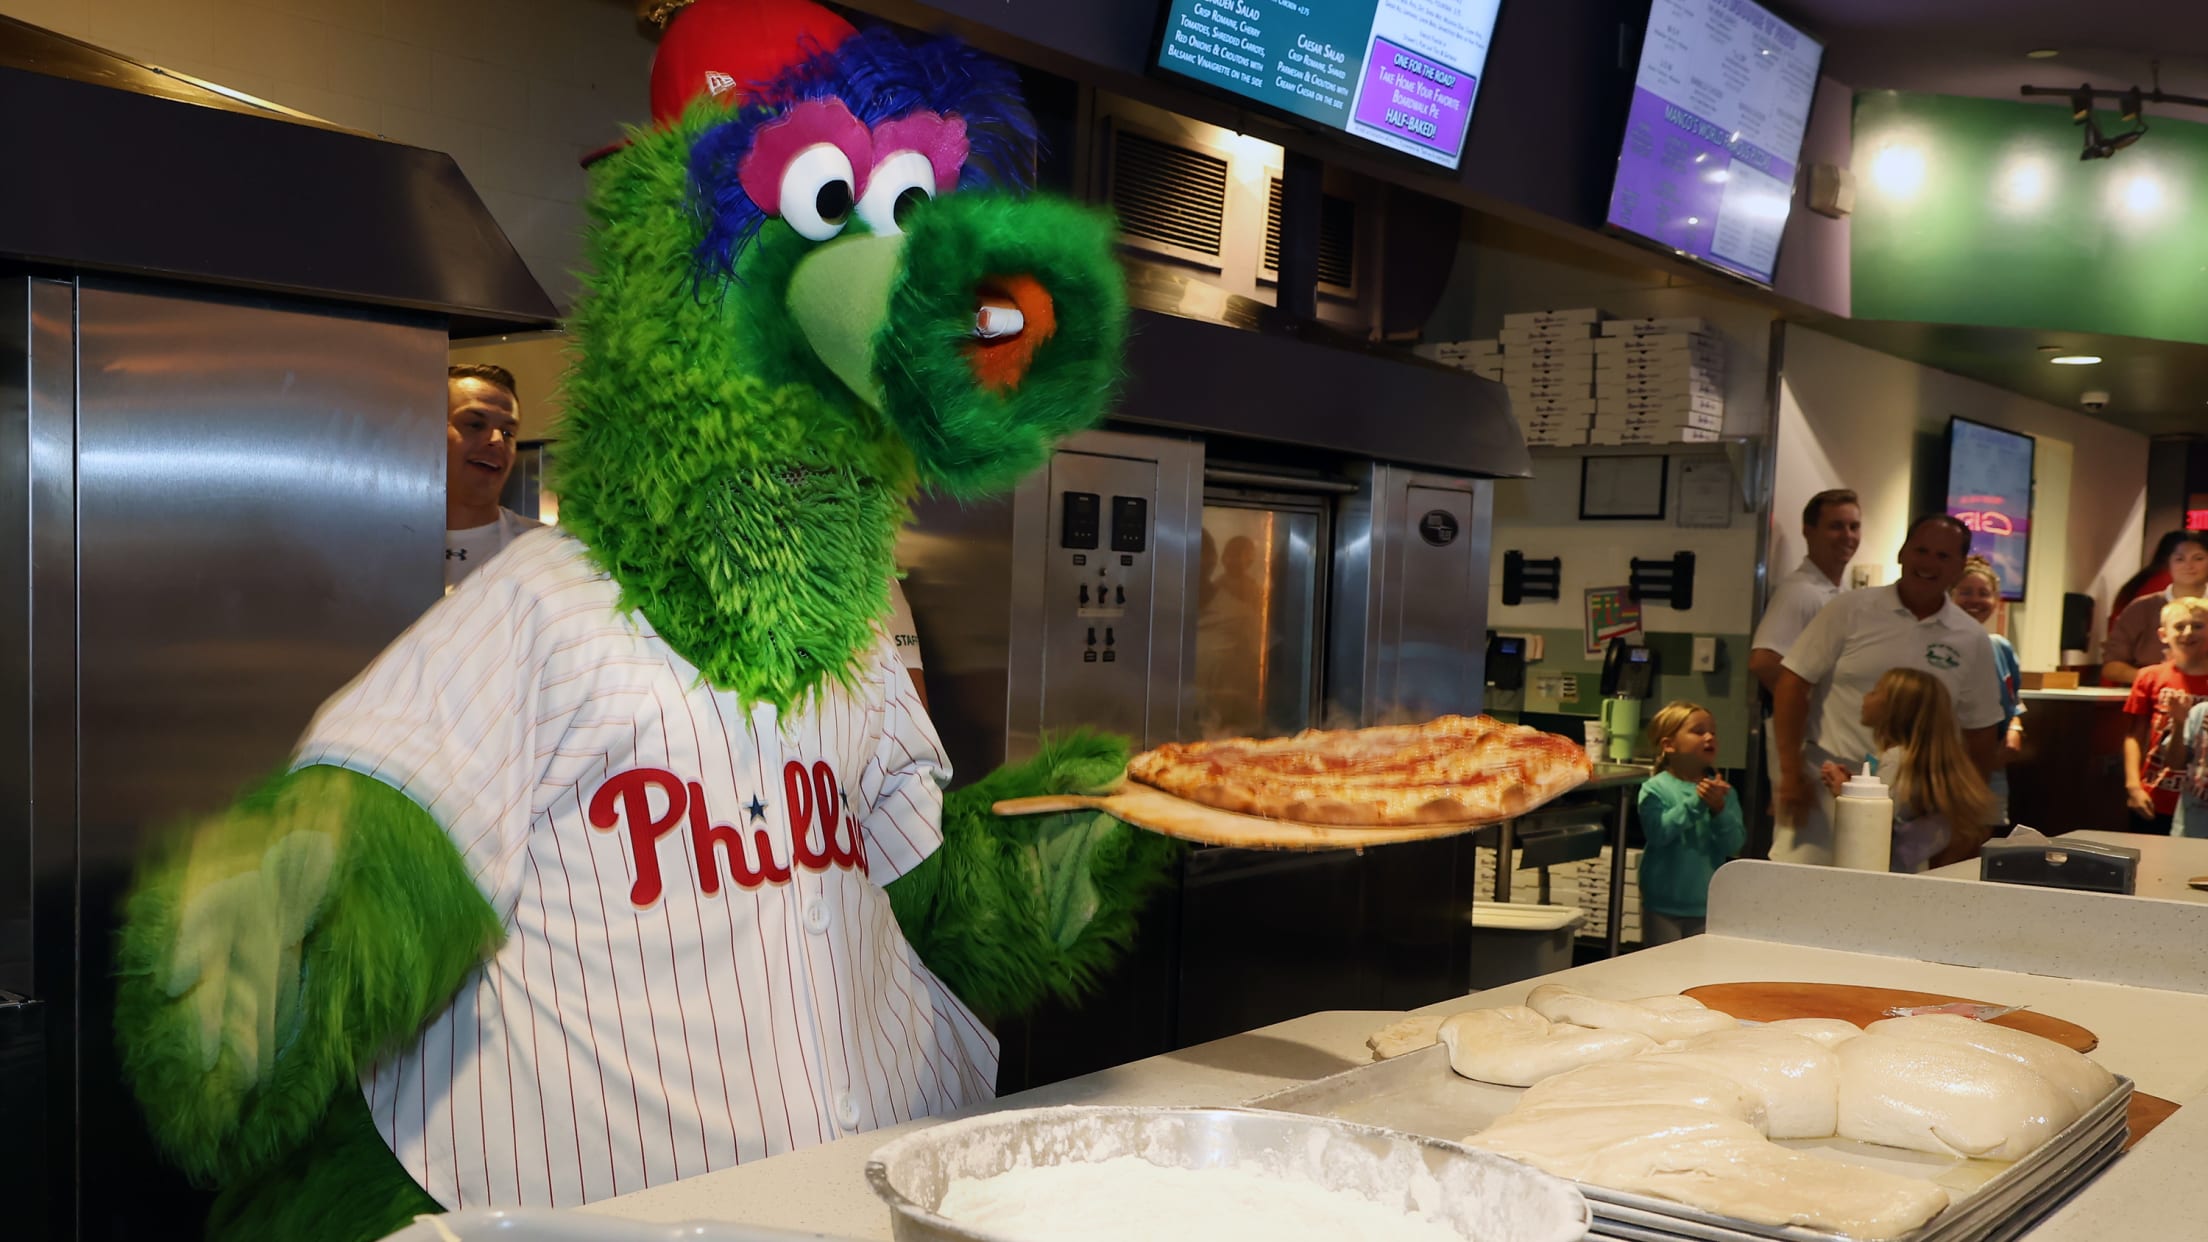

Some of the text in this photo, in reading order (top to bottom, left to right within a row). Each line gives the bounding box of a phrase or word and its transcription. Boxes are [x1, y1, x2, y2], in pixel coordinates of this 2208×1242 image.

[1194, 3, 1211, 18] CRISP
[1240, 21, 1261, 38] CHERRY
[1236, 0, 1260, 20] SALAD
[1175, 30, 1188, 44] RED
[1188, 35, 1212, 53] ONIONS
[1212, 44, 1220, 56] &
[1220, 47, 1249, 66] CROUTONS
[1212, 27, 1240, 47] SHREDDED
[1298, 34, 1345, 64] CAESAR SALAD
[1168, 44, 1196, 64] BALSAMIC
[1197, 54, 1231, 76] VINAIGRETTE
[1288, 49, 1303, 62] CRISP
[1394, 53, 1409, 70] ONE
[1408, 58, 1423, 75] FOR
[1422, 63, 1436, 81] THE
[1304, 71, 1311, 83] &
[1379, 65, 1395, 85] TAKE
[1395, 73, 1416, 93] HOME
[1416, 81, 1433, 99] YOUR
[1385, 107, 1438, 139] HALF-BAKED!
